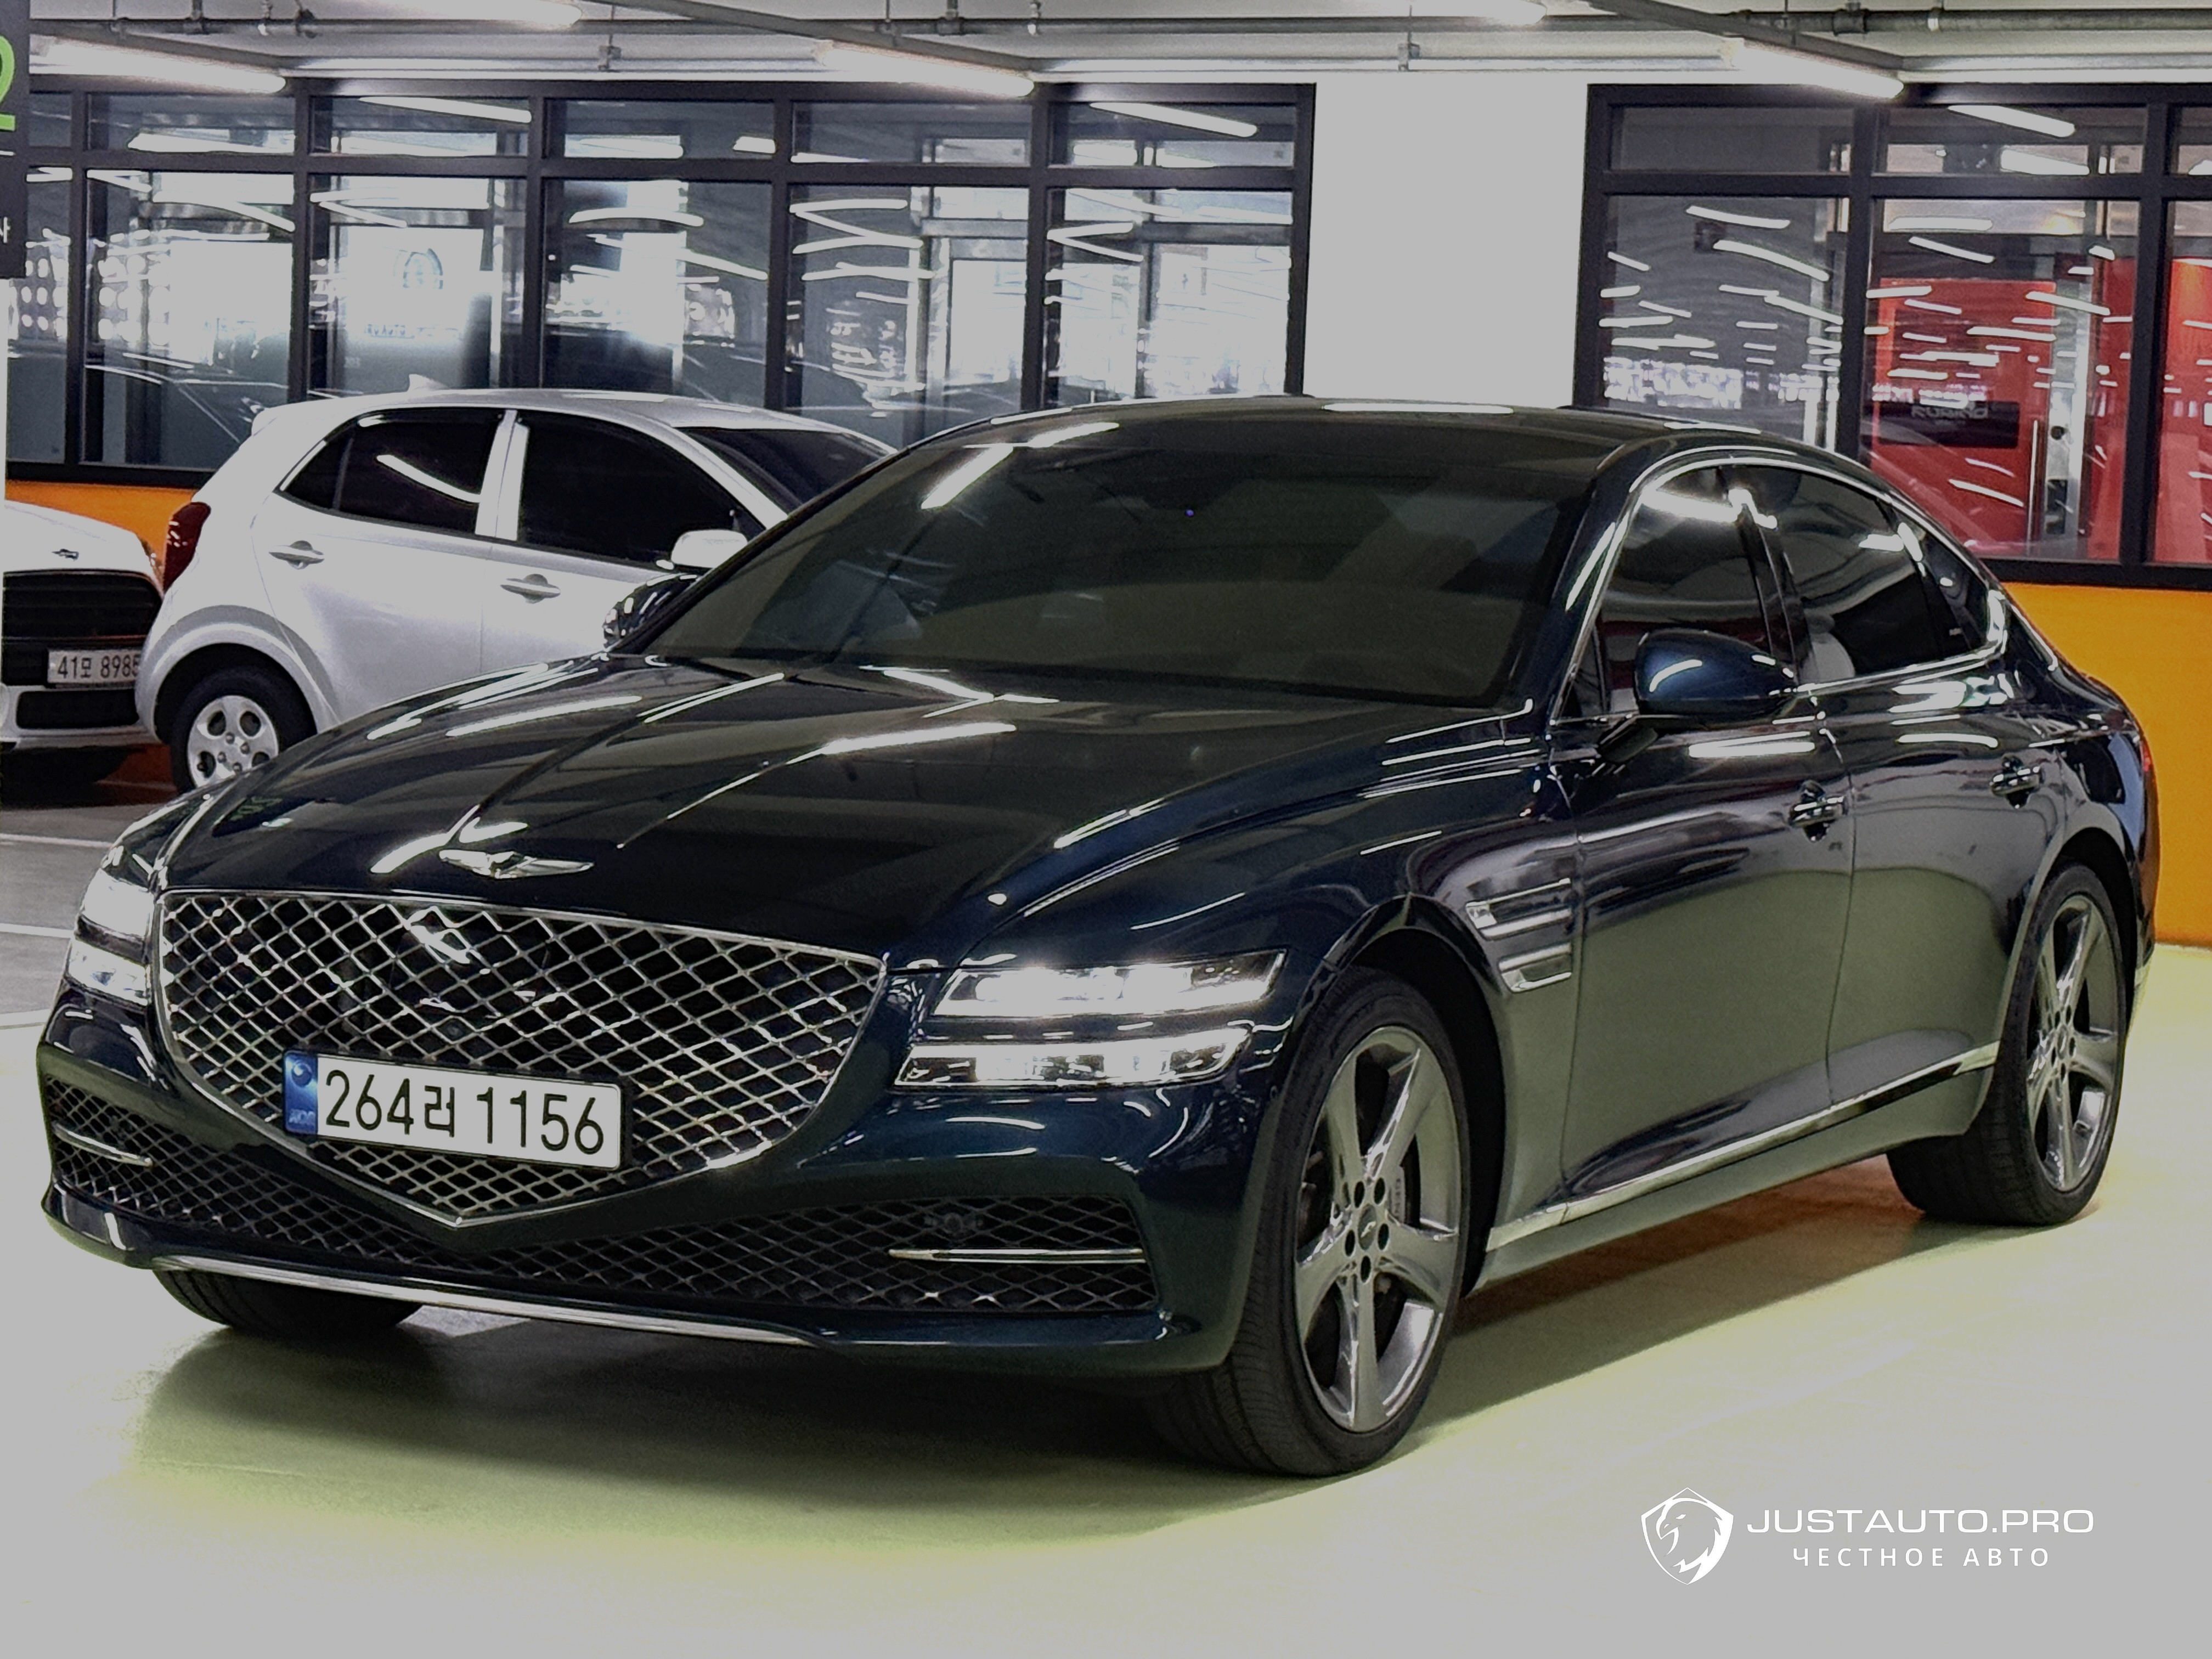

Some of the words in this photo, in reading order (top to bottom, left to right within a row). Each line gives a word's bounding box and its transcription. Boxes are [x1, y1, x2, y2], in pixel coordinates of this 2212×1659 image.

[58, 656, 92, 679] 41모
[325, 1069, 455, 1138] 264러
[477, 1086, 604, 1155] 1156
